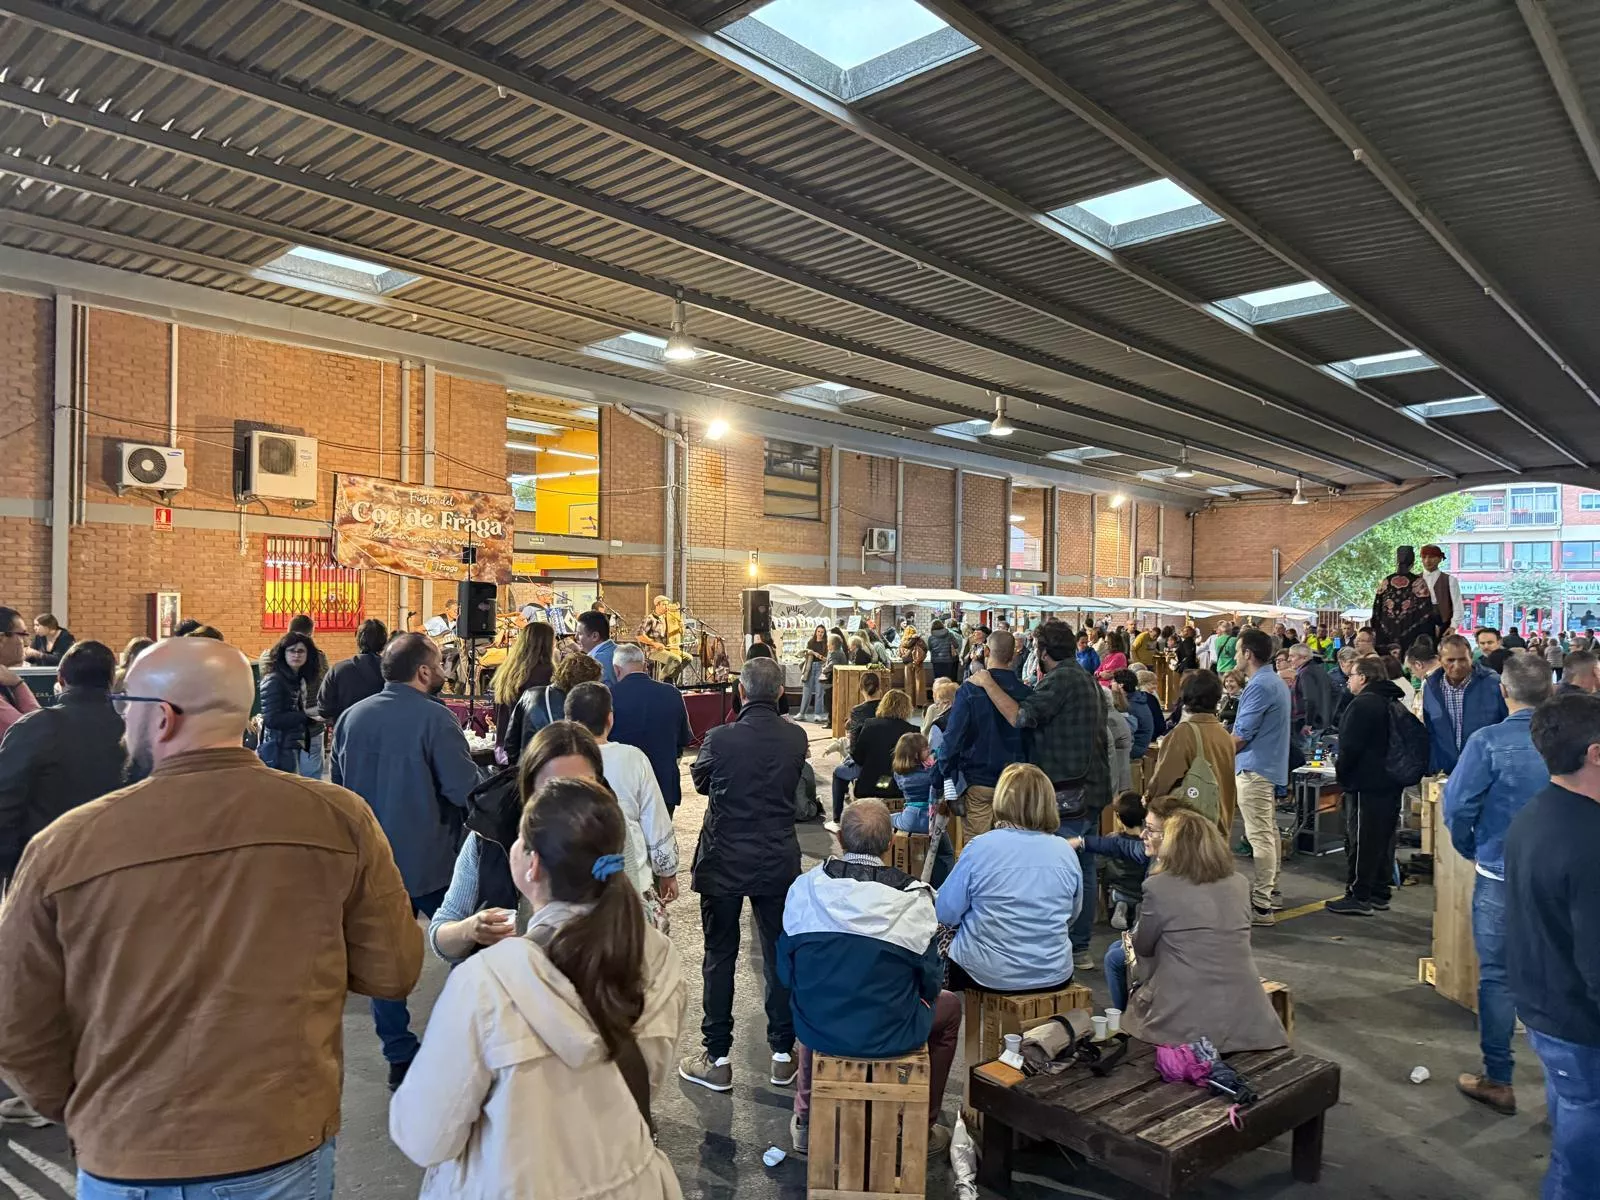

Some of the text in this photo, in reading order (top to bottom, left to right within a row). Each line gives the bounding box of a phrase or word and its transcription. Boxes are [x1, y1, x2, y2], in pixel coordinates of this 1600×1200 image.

[409, 492, 455, 507] Fiesta del
[352, 500, 503, 538] Coc de Fraga
[439, 563, 459, 573] Fraga
